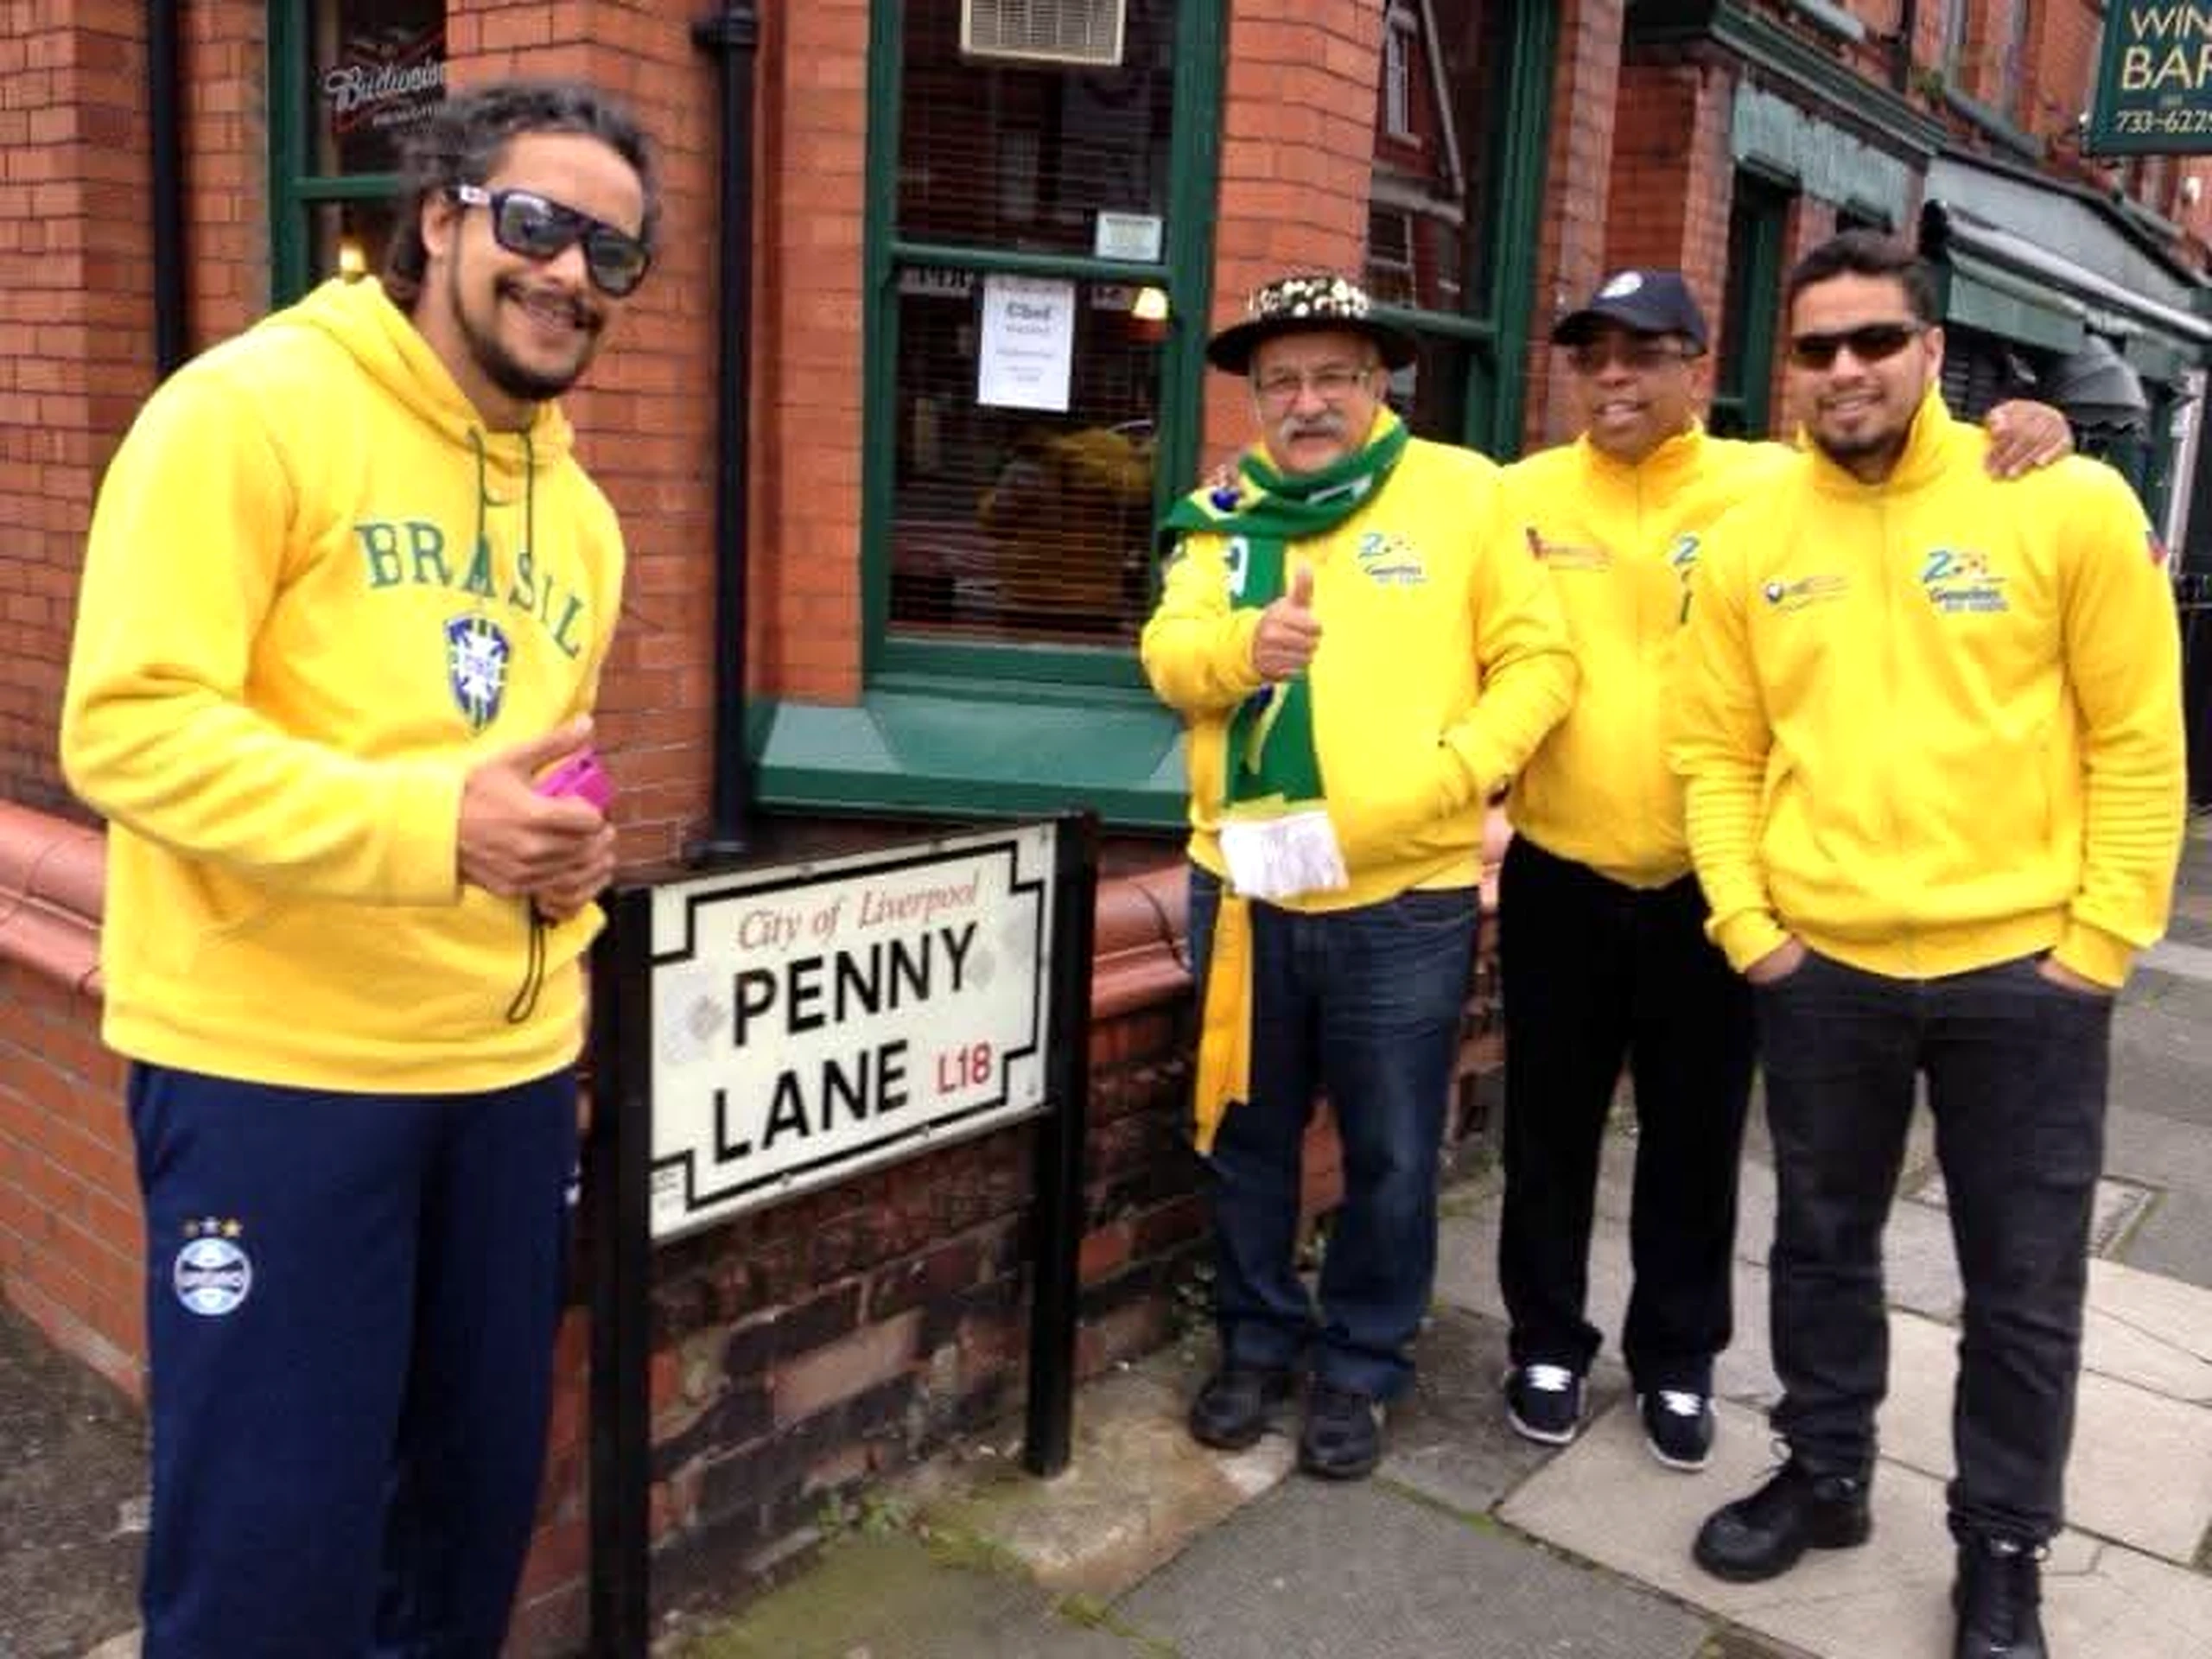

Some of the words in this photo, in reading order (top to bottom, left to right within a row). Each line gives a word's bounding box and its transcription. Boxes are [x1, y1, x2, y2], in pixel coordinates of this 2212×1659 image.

[353, 521, 584, 660] BRASIL
[739, 907, 802, 951] City
[813, 894, 845, 941] of
[858, 867, 981, 930] Liverpool
[733, 921, 978, 1048] PENNY
[712, 1039, 909, 1165] LANE
[937, 1041, 993, 1096] L18
